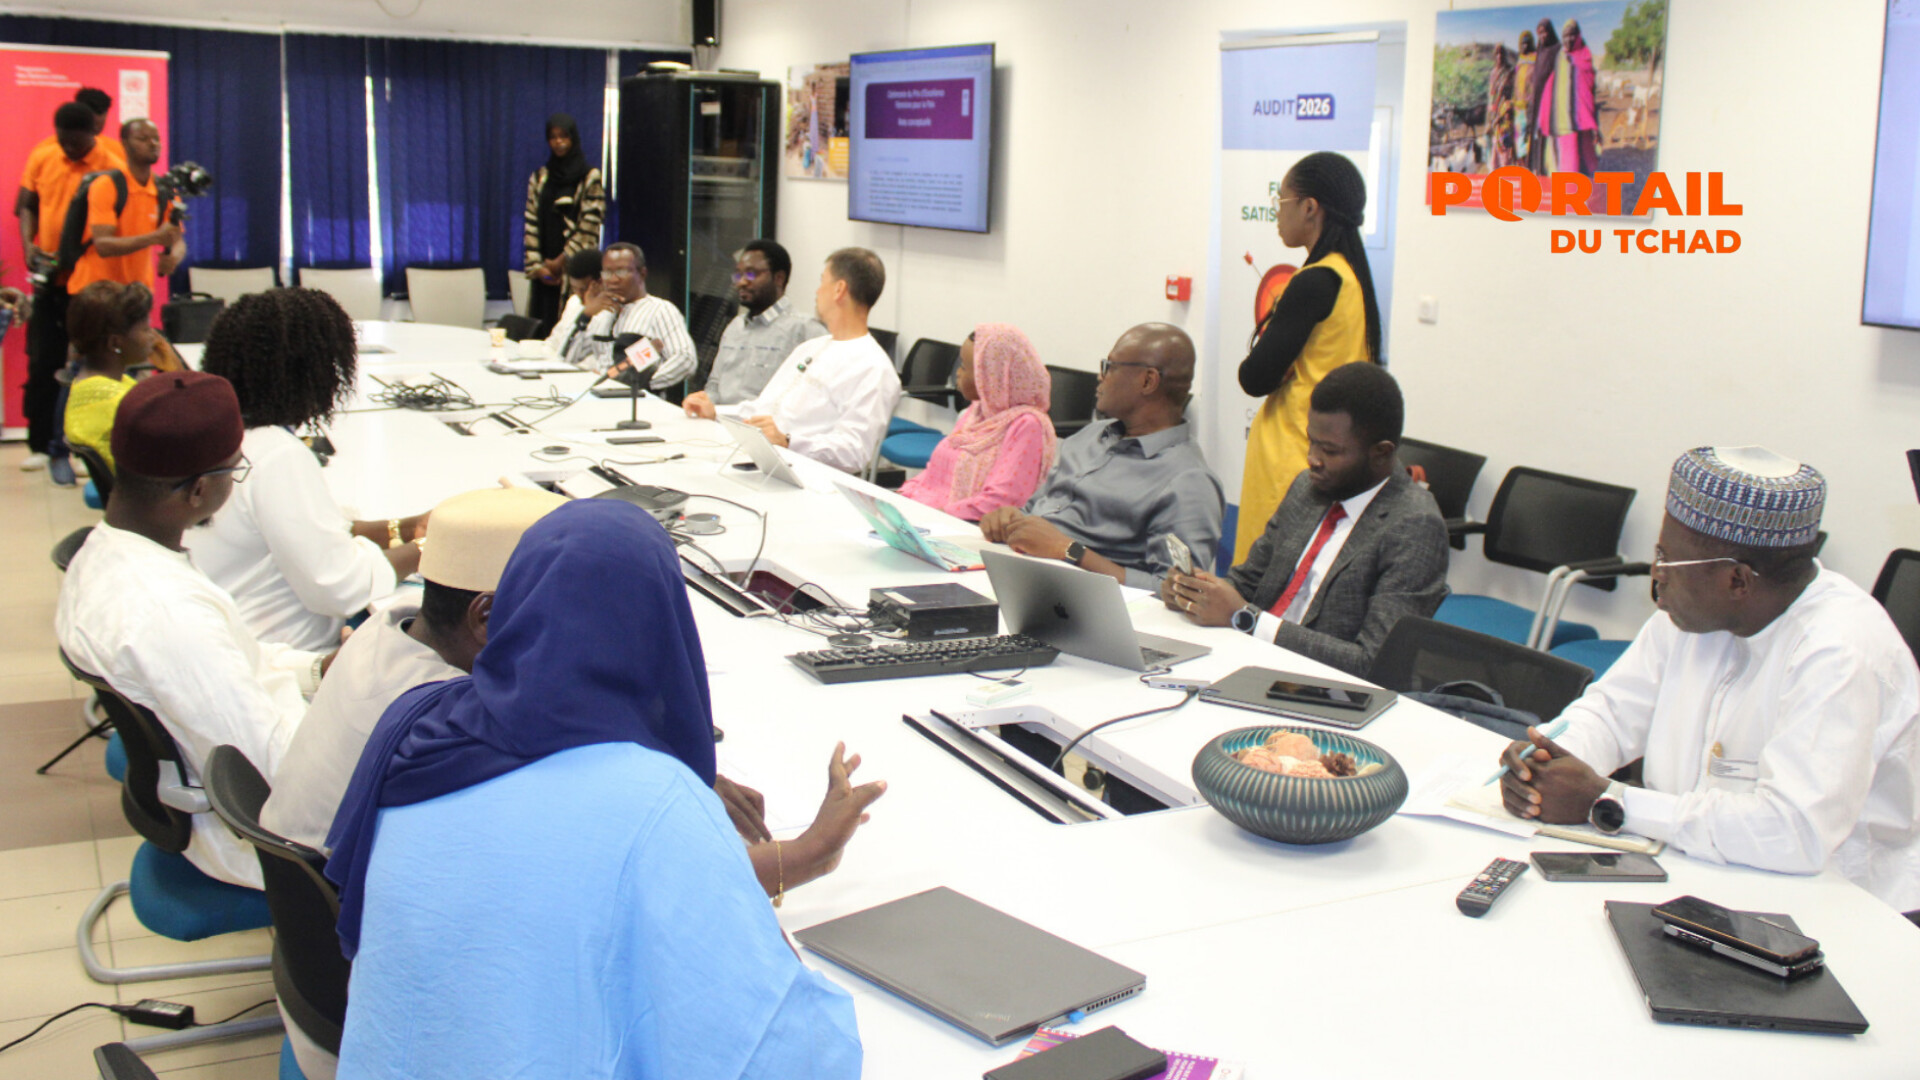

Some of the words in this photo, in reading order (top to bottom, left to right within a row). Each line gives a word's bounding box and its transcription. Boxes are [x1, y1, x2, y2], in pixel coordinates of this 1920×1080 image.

[1253, 99, 1295, 116] AUDIT
[1298, 98, 1331, 116] 2026
[1241, 206, 1278, 223] SATIS
